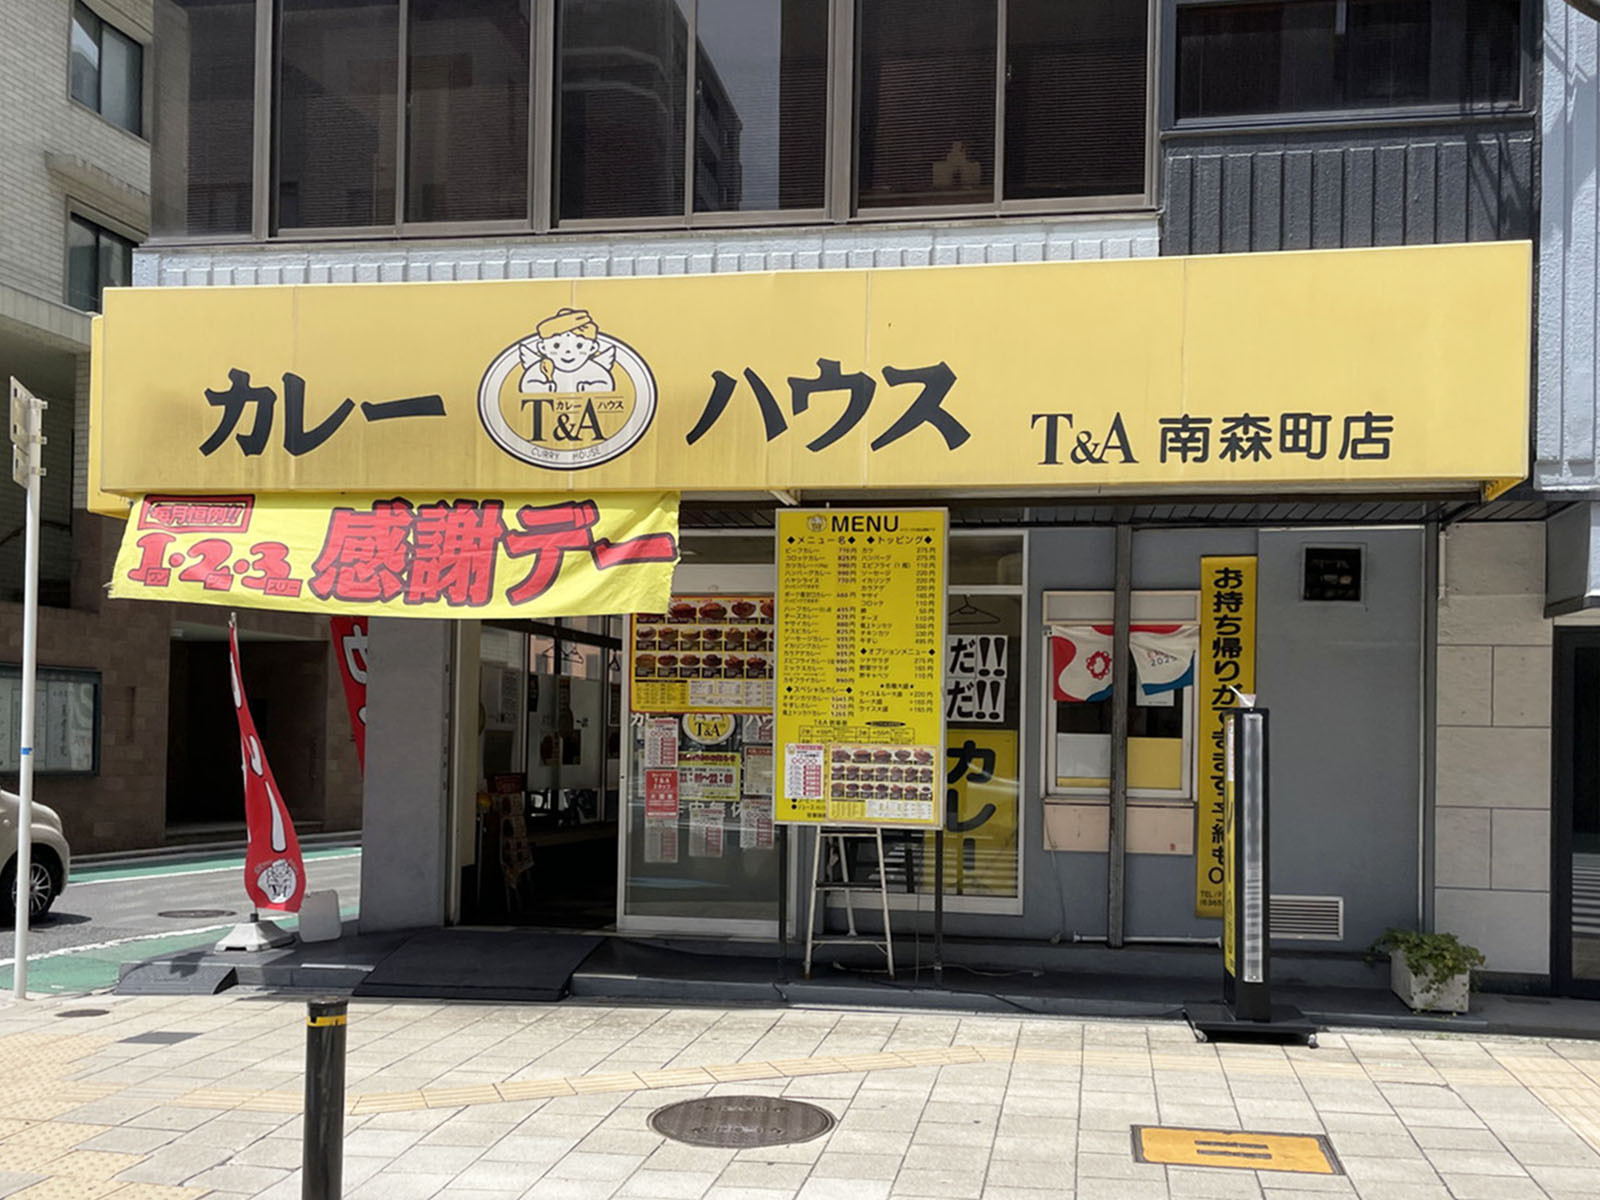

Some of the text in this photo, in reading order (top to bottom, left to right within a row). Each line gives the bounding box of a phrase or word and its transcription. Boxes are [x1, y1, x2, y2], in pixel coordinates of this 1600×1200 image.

[200, 357, 971, 457] カレー ハウス
[556, 401, 624, 410] カレー ハウス
[521, 398, 609, 441] T&A
[1030, 411, 1395, 466] T&A 南森町店
[531, 447, 602, 461] CURRY HOUSE
[831, 515, 899, 533] MENU
[878, 536, 923, 545] トッピング
[310, 498, 678, 607] 感謝デー
[695, 722, 721, 738] T&A
